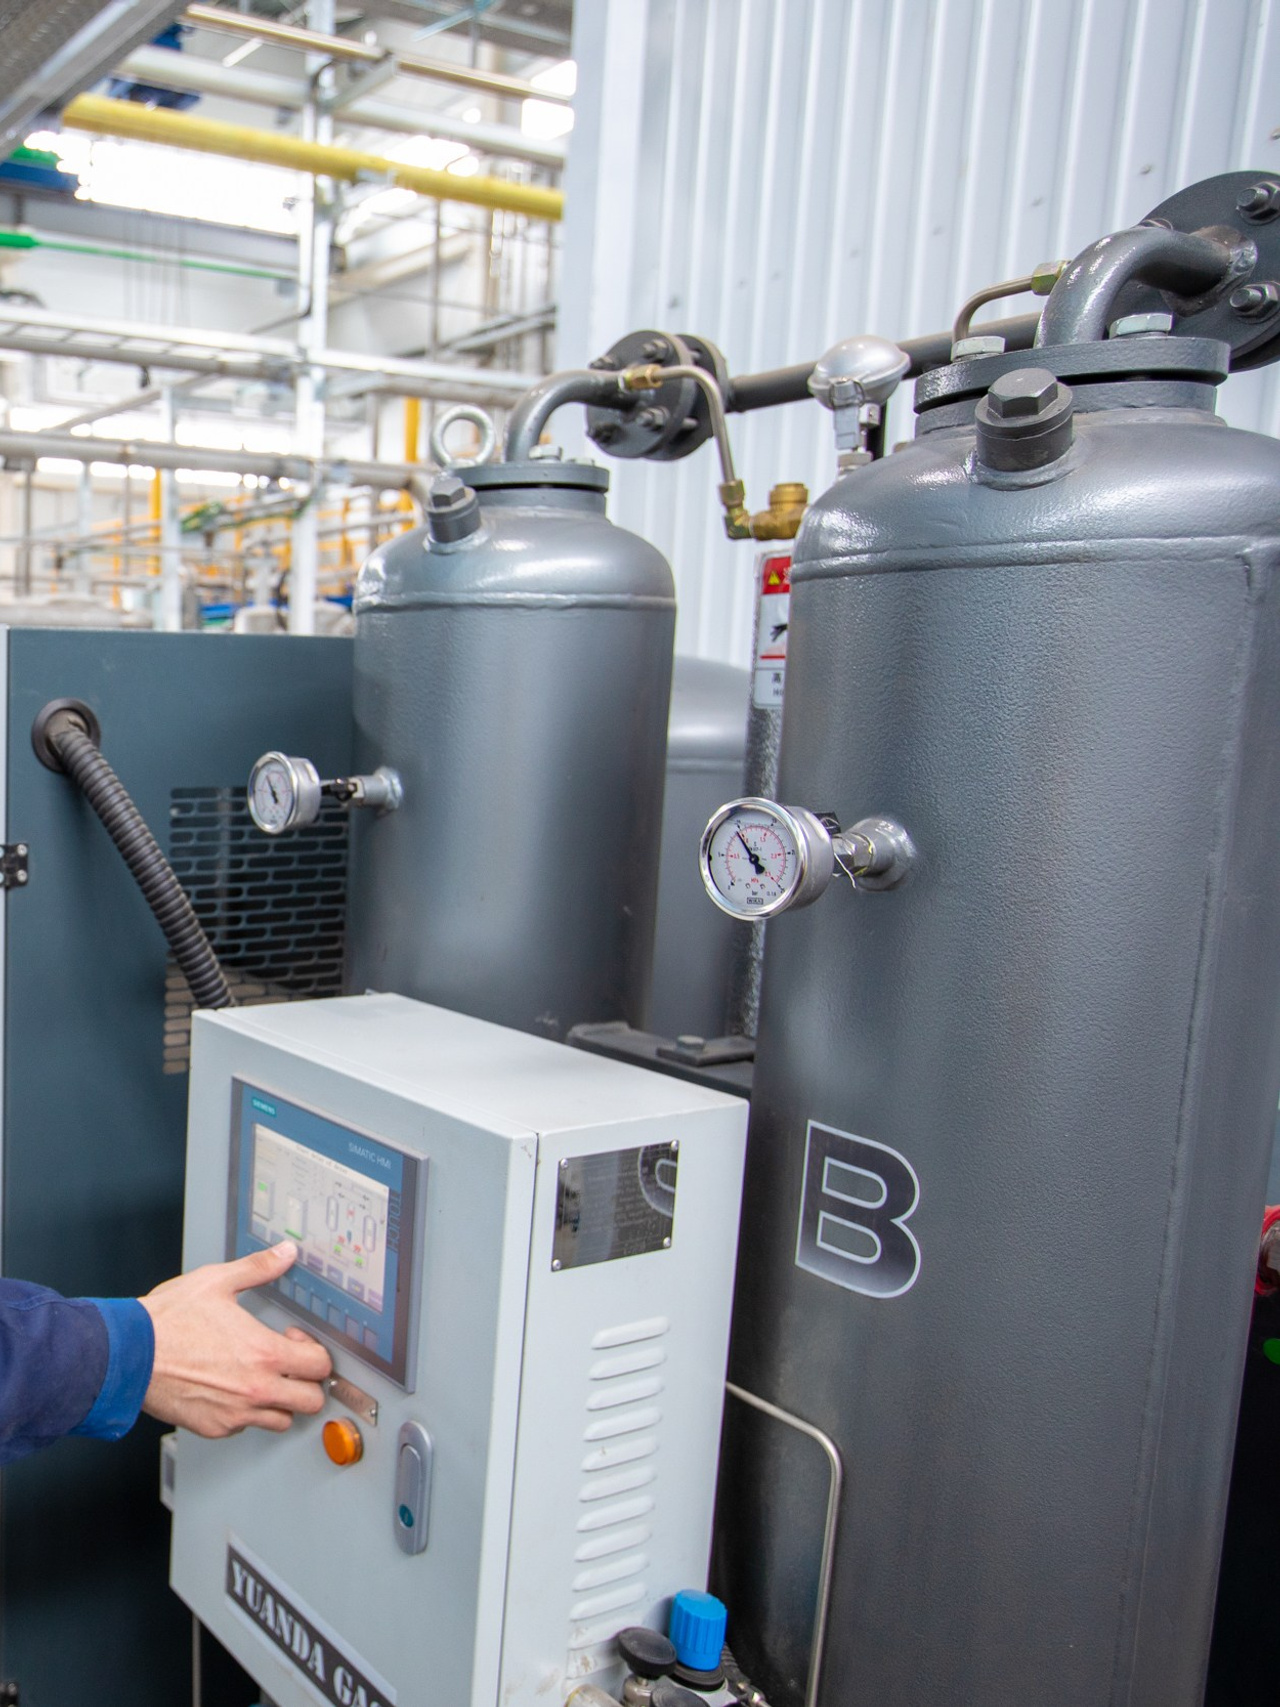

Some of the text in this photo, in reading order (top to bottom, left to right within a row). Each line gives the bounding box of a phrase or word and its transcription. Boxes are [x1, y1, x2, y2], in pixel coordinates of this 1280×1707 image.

[349, 1142, 376, 1162] SIMATIC
[795, 1119, 921, 1299] B
[231, 1560, 382, 1707] YUANDA GA
